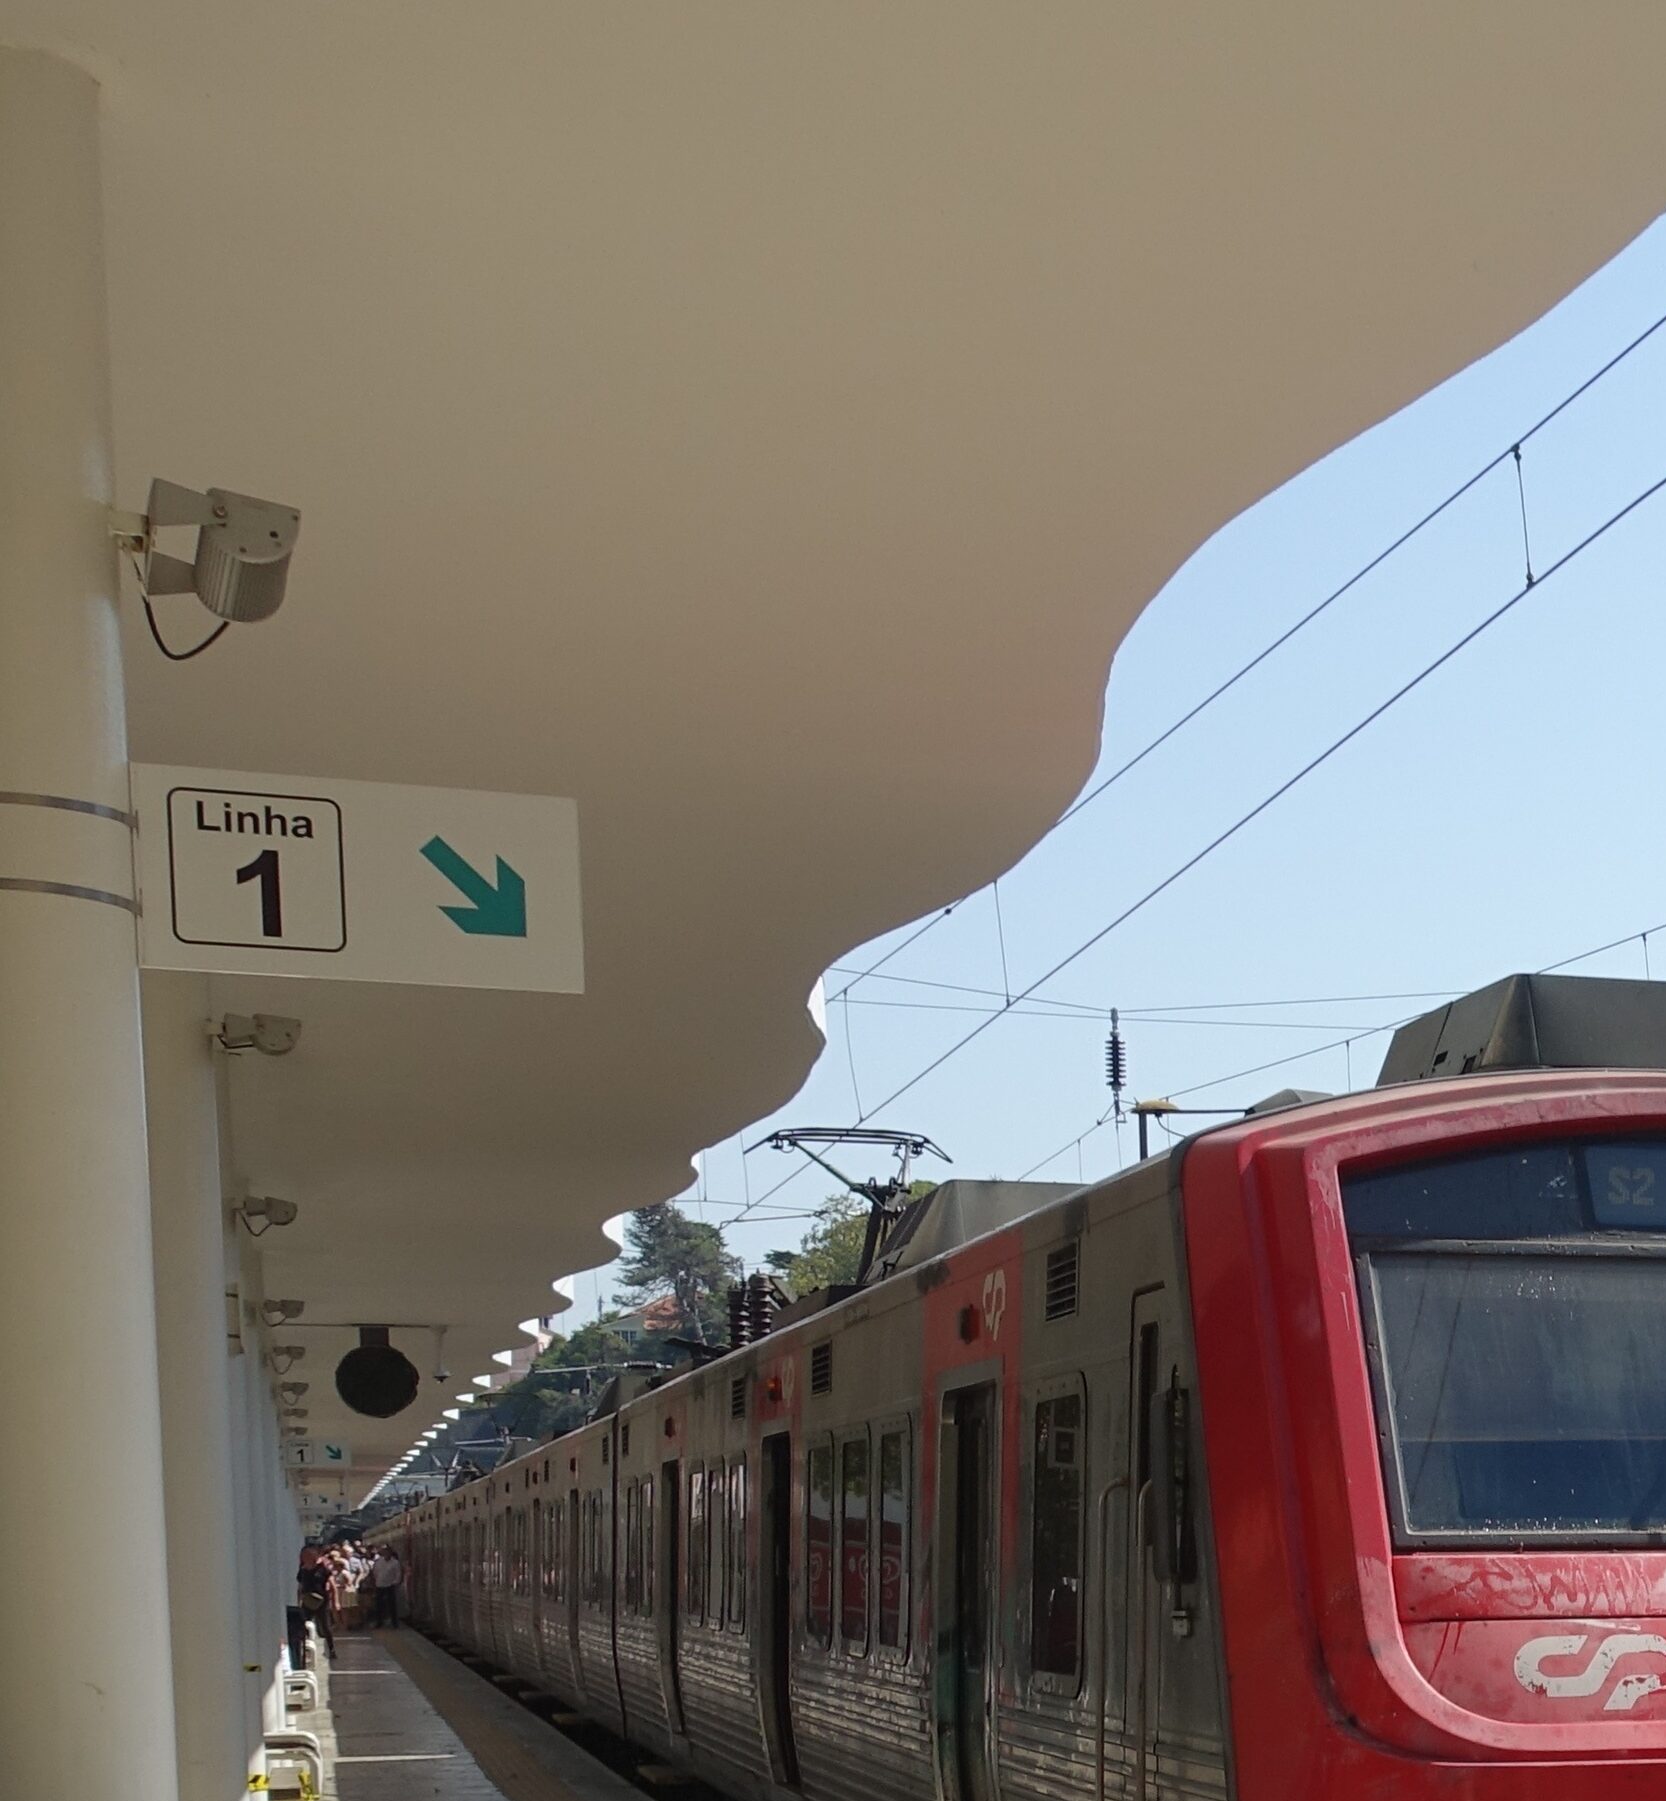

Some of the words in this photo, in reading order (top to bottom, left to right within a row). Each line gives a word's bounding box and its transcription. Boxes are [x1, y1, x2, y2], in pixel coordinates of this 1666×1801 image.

[195, 800, 315, 840] Linha
[235, 848, 284, 938] 1
[1607, 1165, 1655, 1207] S2
[296, 1448, 305, 1463] 1
